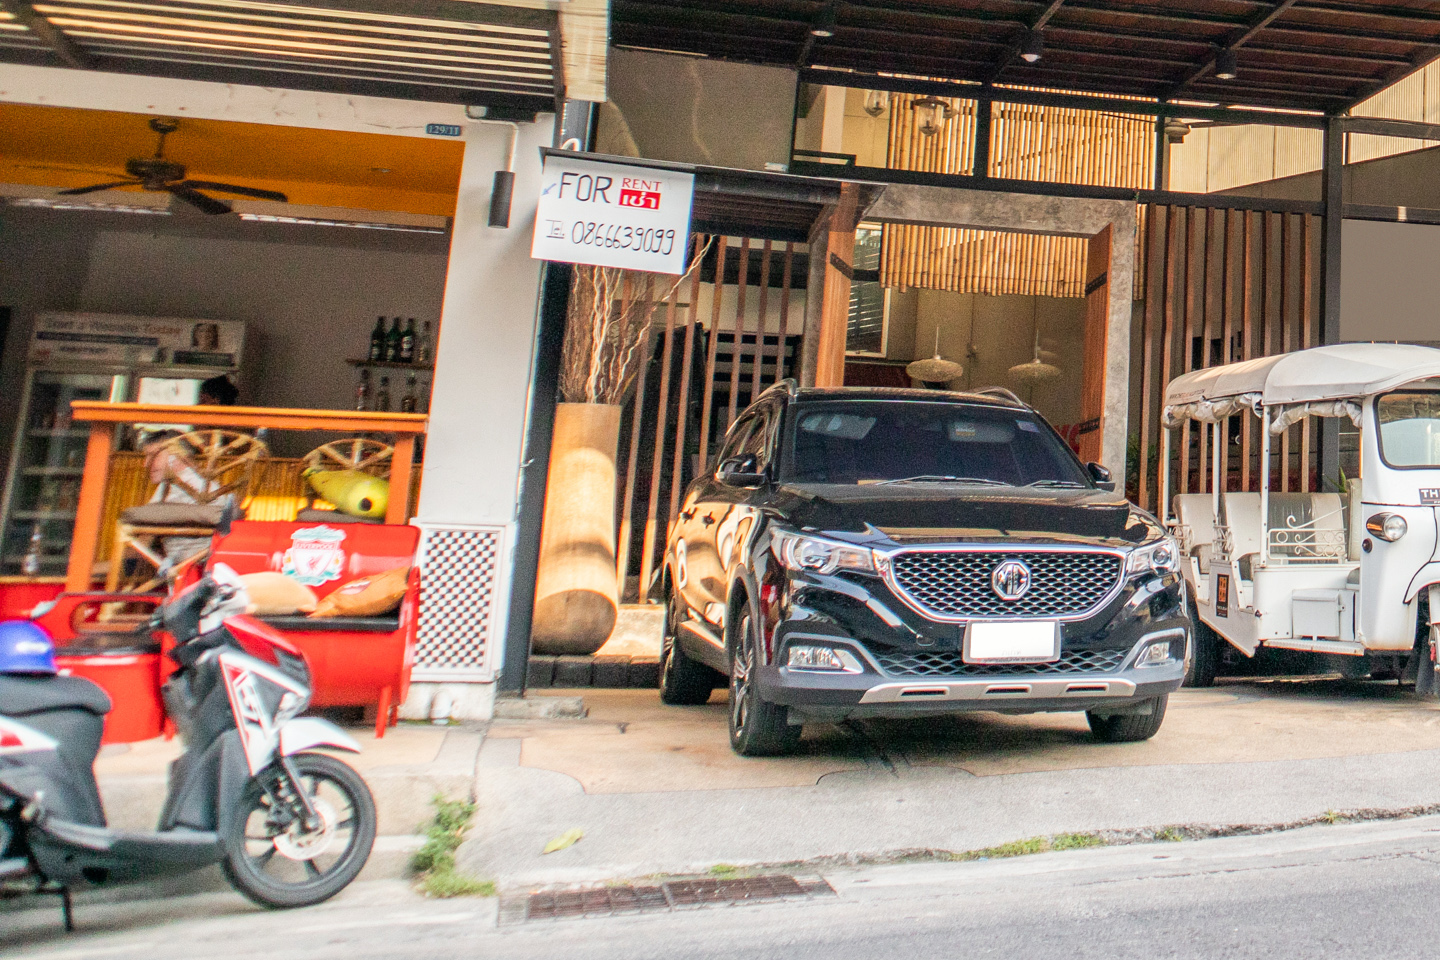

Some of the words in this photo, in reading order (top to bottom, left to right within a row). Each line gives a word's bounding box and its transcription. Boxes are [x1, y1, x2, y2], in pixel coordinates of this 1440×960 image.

[558, 171, 614, 204] FOR
[621, 177, 663, 192] RENT
[622, 191, 657, 209] เช่า
[571, 220, 676, 256] 0866639099
